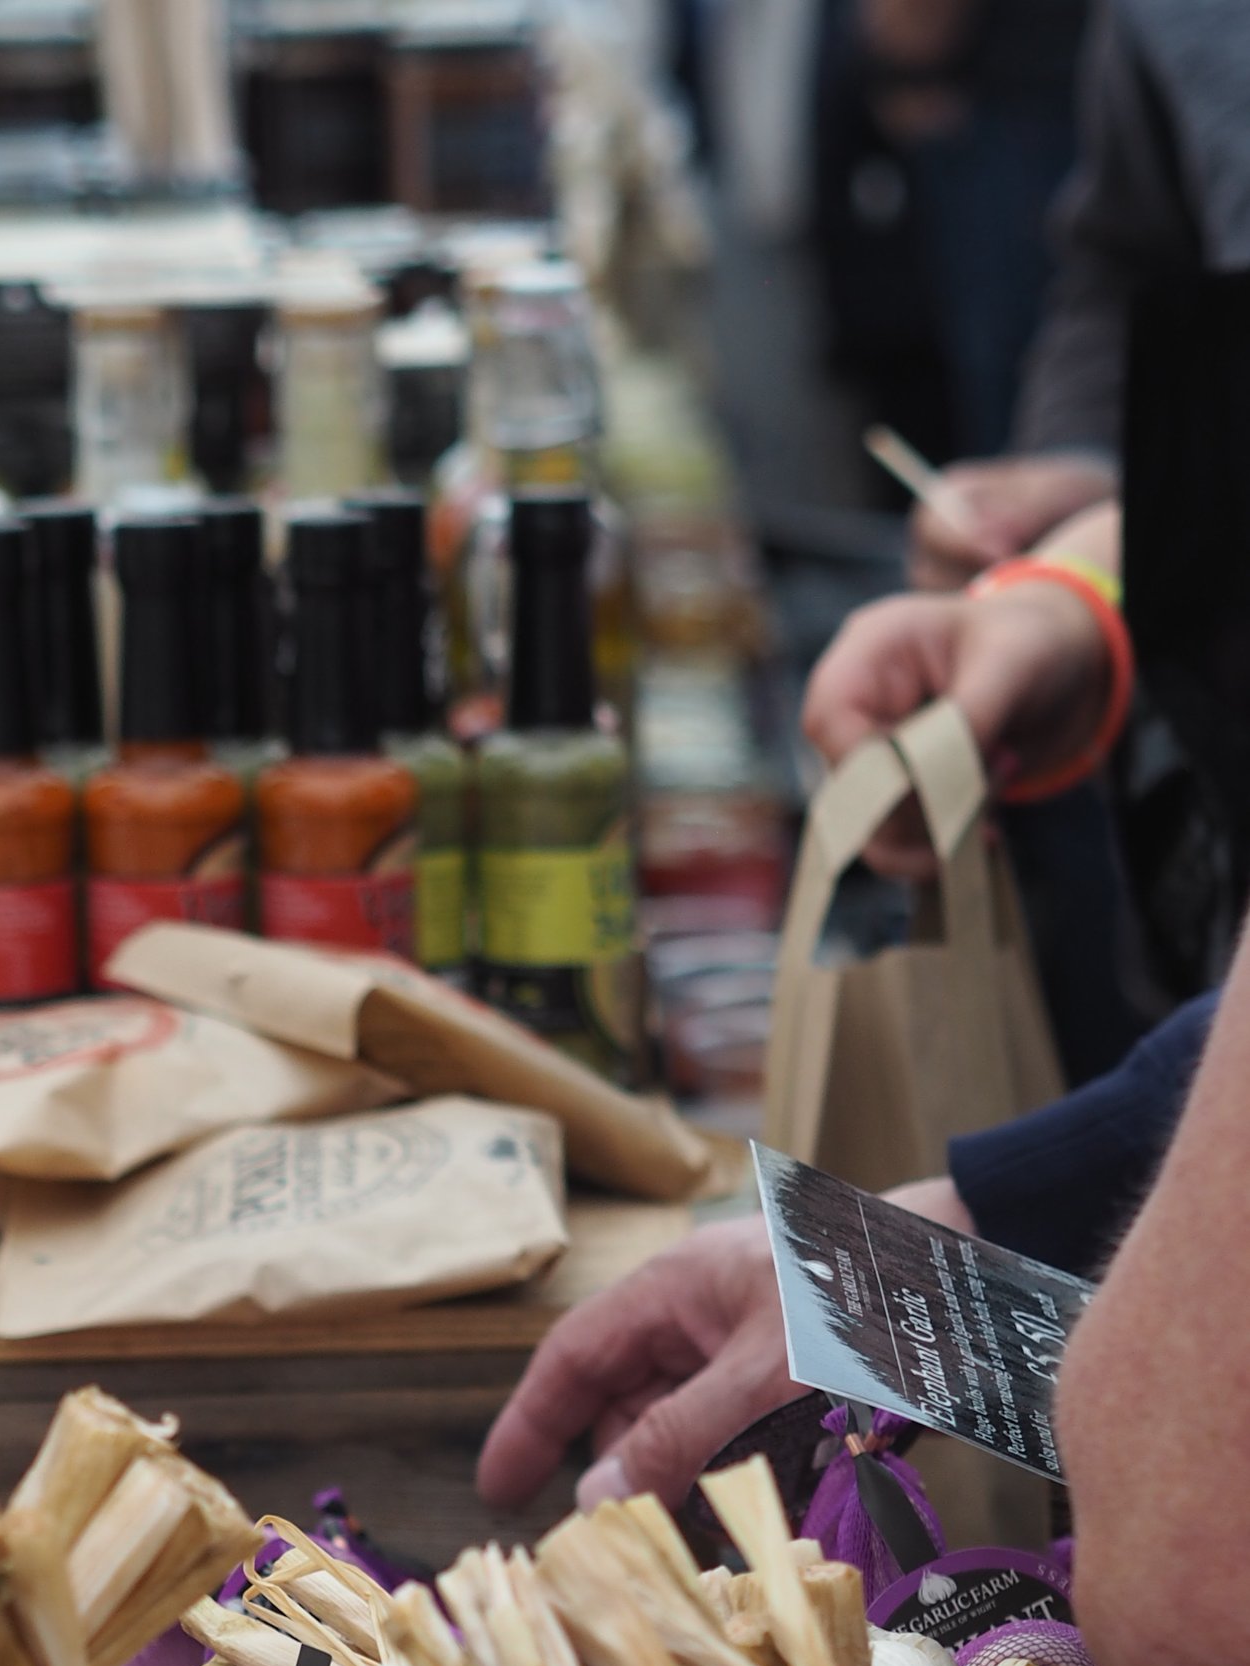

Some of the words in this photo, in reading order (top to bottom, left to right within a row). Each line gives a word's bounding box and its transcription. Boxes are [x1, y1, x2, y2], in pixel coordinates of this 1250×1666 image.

[892, 1287, 936, 1343] Garlic
[910, 1341, 961, 1428] Elephant
[958, 1364, 979, 1388] with
[965, 1386, 987, 1416] bulbs
[998, 1404, 1019, 1423] for
[974, 1415, 996, 1444] Huge
[1029, 1409, 1049, 1424] for
[1003, 1420, 1027, 1459] Perfect
[1031, 1422, 1054, 1447] and
[908, 1592, 971, 1636] GARLIC
[969, 1568, 1021, 1605] FARM
